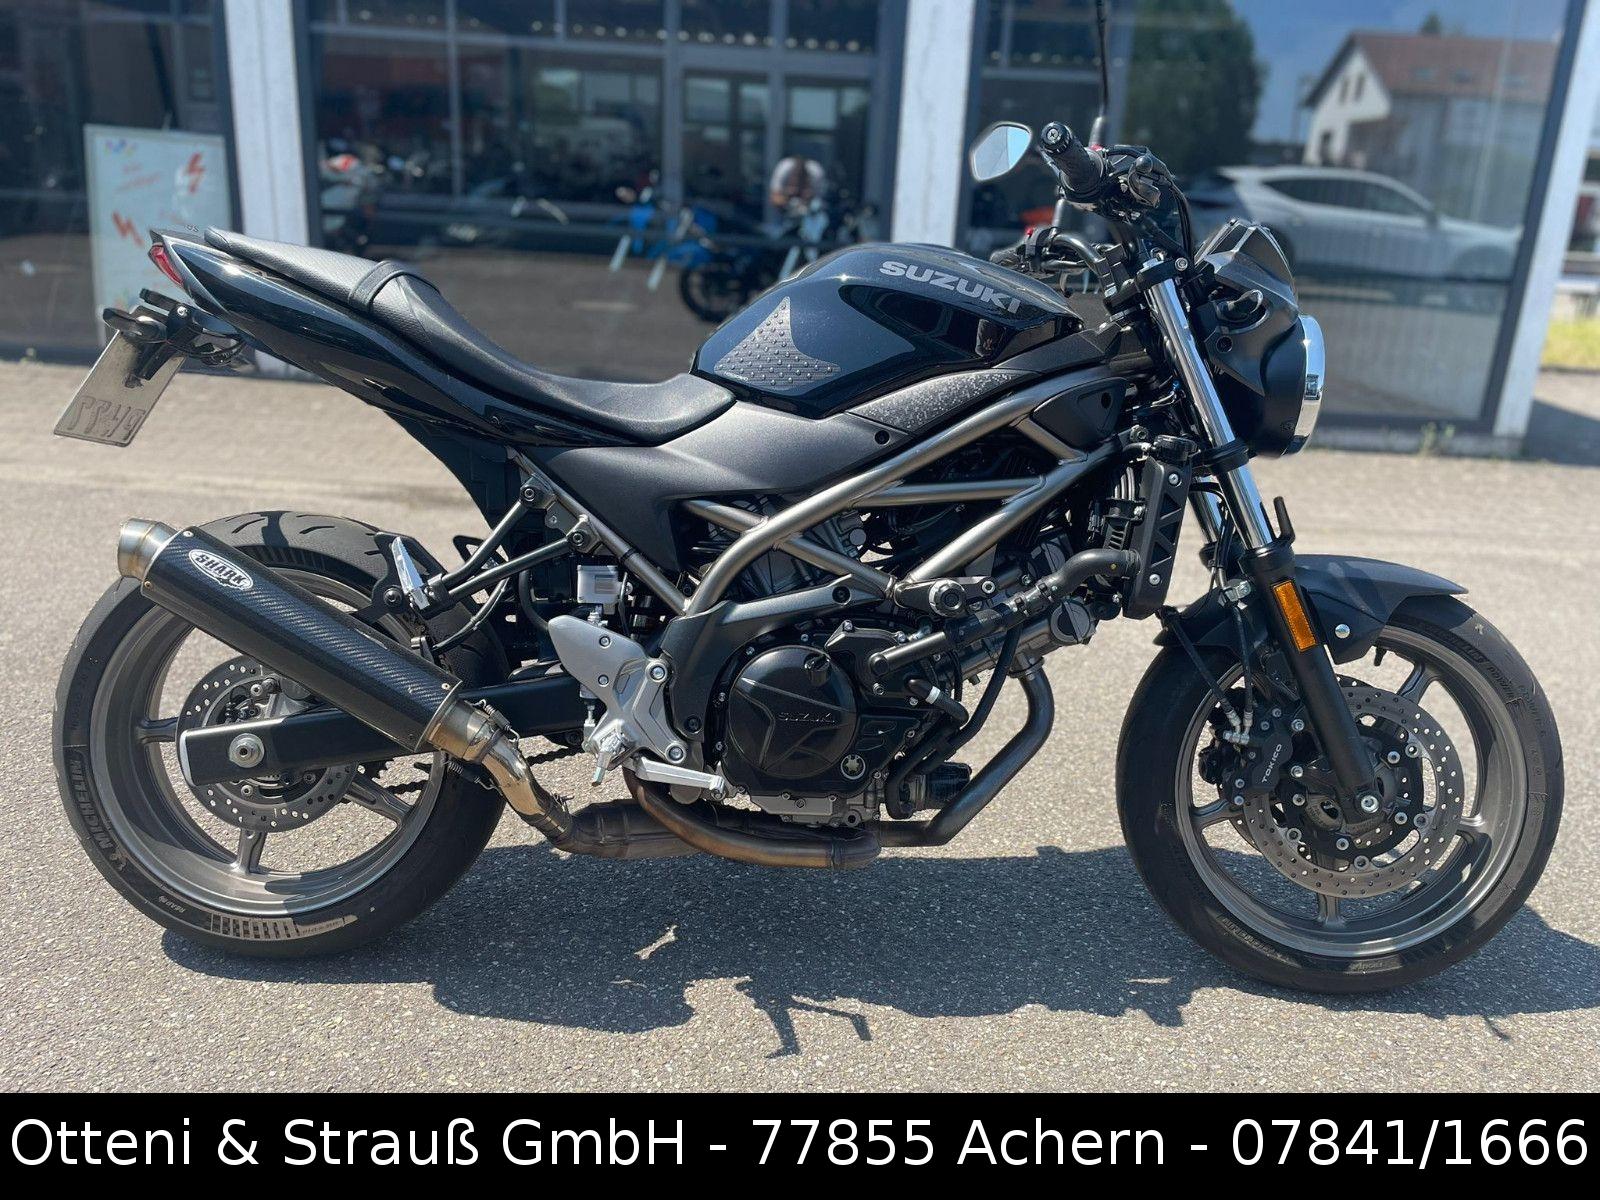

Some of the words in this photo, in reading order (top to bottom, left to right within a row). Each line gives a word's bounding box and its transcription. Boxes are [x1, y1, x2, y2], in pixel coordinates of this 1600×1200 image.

[880, 261, 1021, 314] SUZUKI
[195, 554, 247, 585] SHARK
[1261, 743, 1282, 783] TOKICO
[69, 760, 117, 850] MICHELIN
